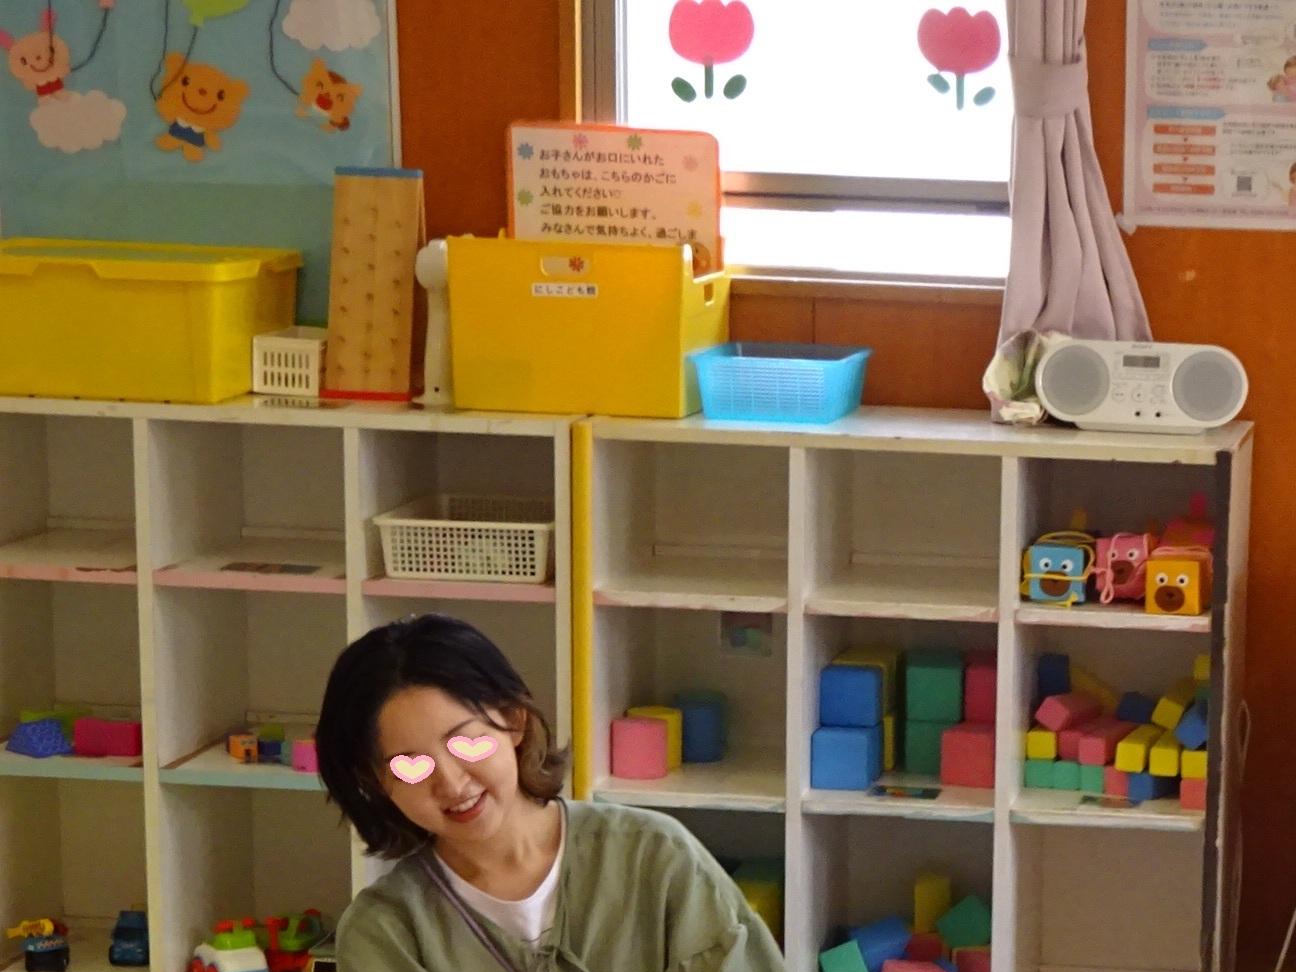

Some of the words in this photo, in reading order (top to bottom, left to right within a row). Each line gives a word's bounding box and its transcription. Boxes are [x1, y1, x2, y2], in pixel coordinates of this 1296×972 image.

[539, 149, 665, 166] お子さんがお口にいれた
[539, 167, 677, 185] おもちゃは、こちらのかごに
[540, 202, 657, 220] ご協力をお願いします。
